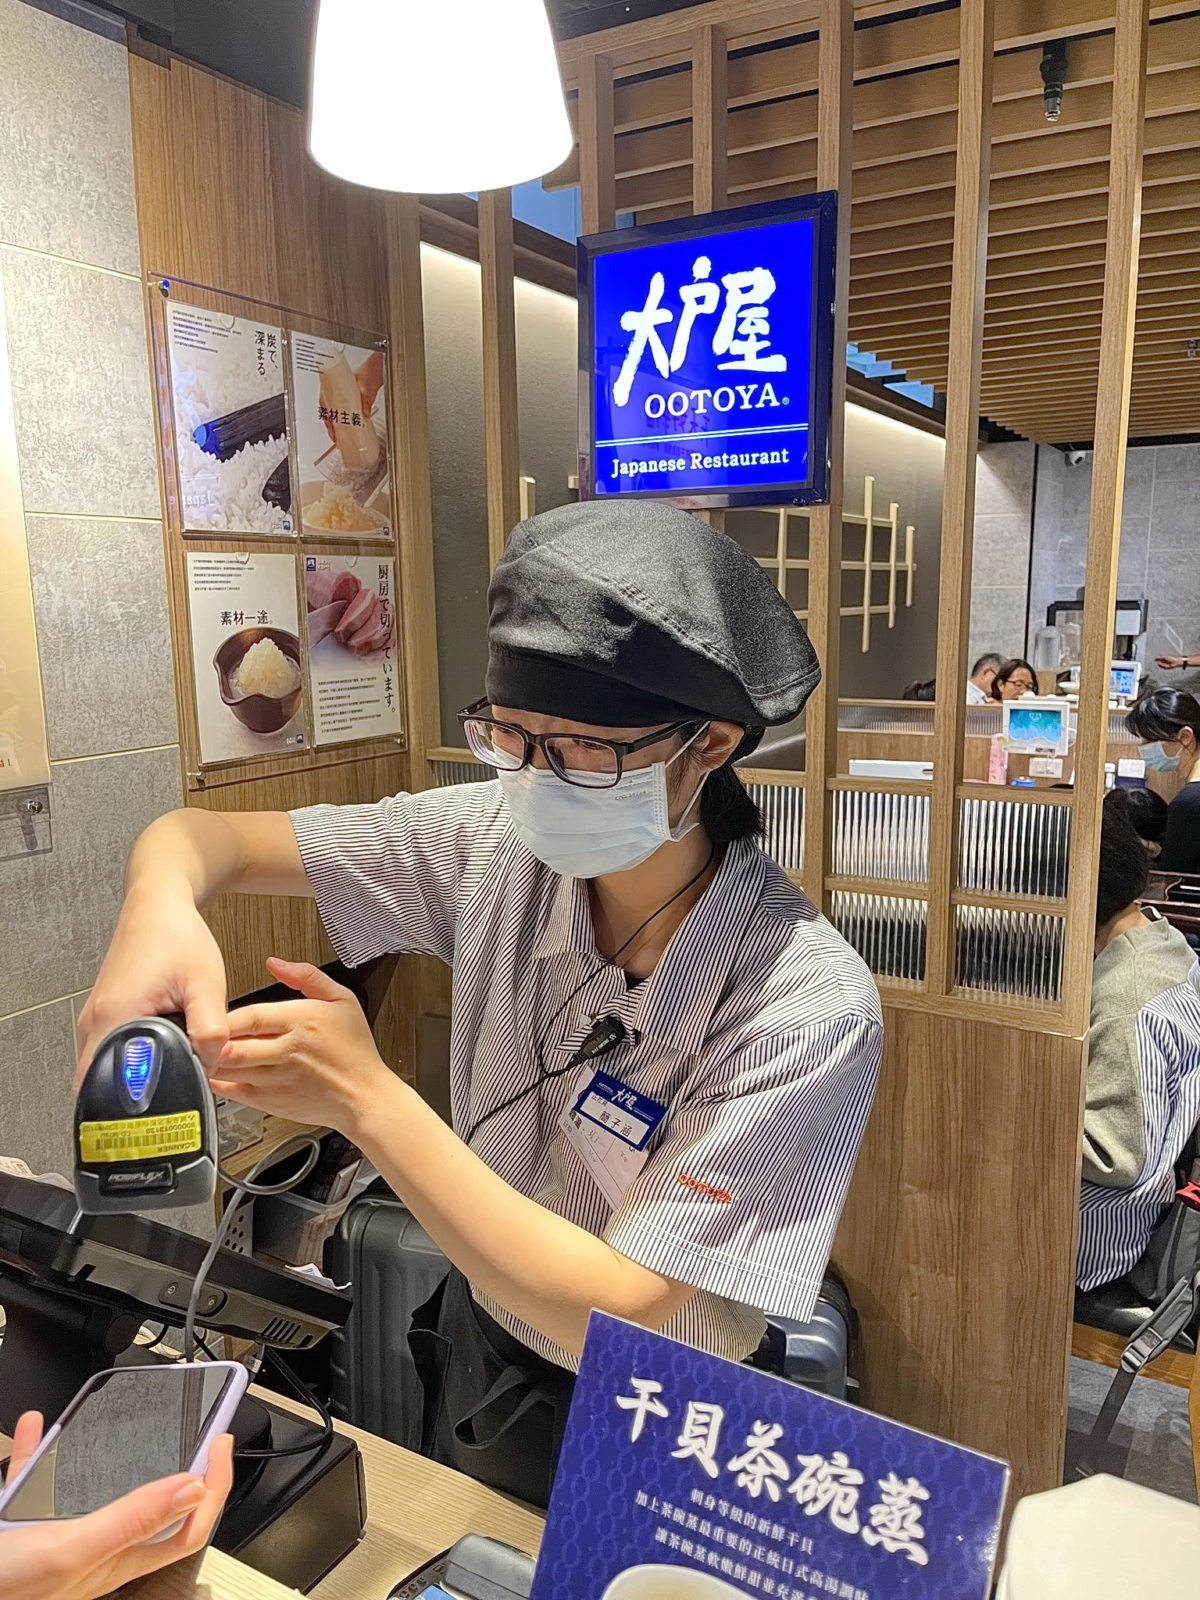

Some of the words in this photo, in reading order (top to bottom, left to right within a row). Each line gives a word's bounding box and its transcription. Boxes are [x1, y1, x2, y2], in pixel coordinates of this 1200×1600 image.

[644, 382, 780, 419] OOTOYA
[611, 457, 686, 478] Japanese
[690, 448, 789, 470] Restaurant
[615, 1376, 930, 1566] 干貝茶碗蒸
[690, 1488, 813, 1555] 刺身等級的新鮮干貝
